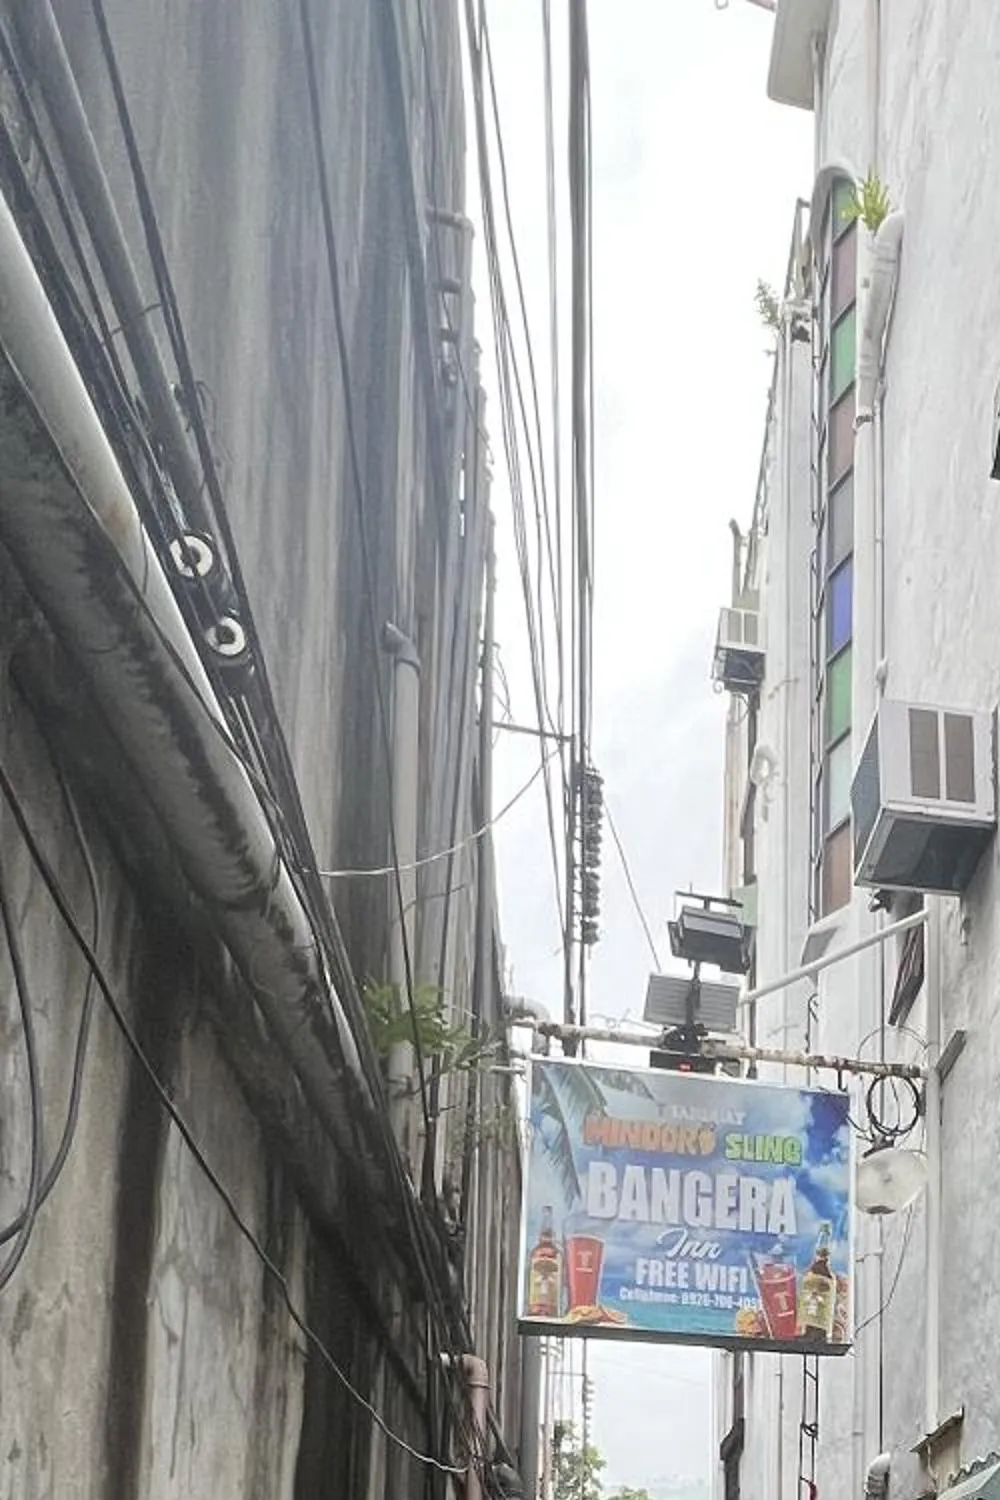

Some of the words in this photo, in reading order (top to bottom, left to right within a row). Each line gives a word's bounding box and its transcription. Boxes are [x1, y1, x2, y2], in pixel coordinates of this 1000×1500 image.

[583, 1115, 717, 1156] MINDORO
[725, 1133, 801, 1166] SLING
[587, 1161, 797, 1235] BANGERA
[656, 1228, 723, 1259] Inn
[635, 1258, 689, 1289] FREE
[697, 1263, 748, 1294] WIFI
